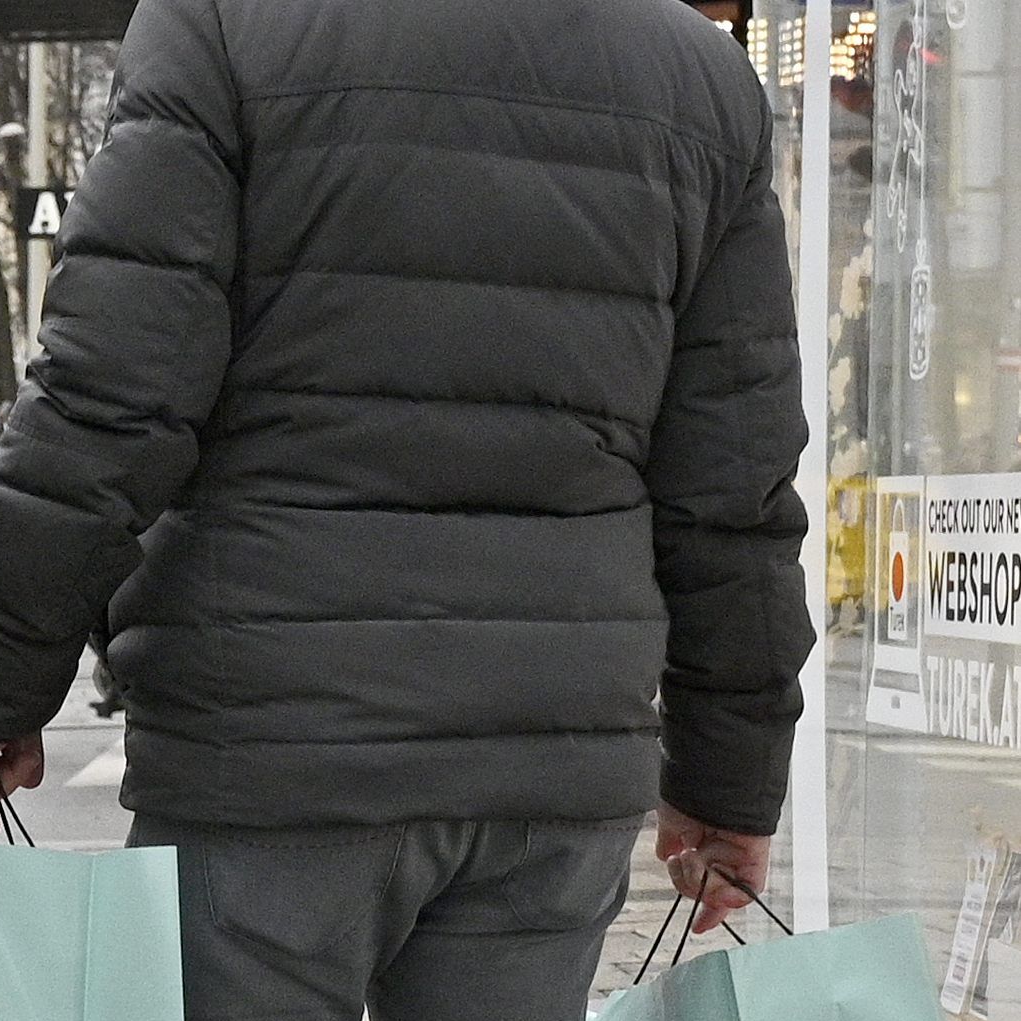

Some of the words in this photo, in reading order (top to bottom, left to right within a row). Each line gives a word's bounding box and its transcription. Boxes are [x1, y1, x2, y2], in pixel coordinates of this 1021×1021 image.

[928, 498, 959, 534] CHECK
[961, 498, 981, 534] OUT
[983, 498, 1004, 534] OUR
[1006, 498, 1021, 534] NE
[928, 550, 1021, 627] WEBSHOP
